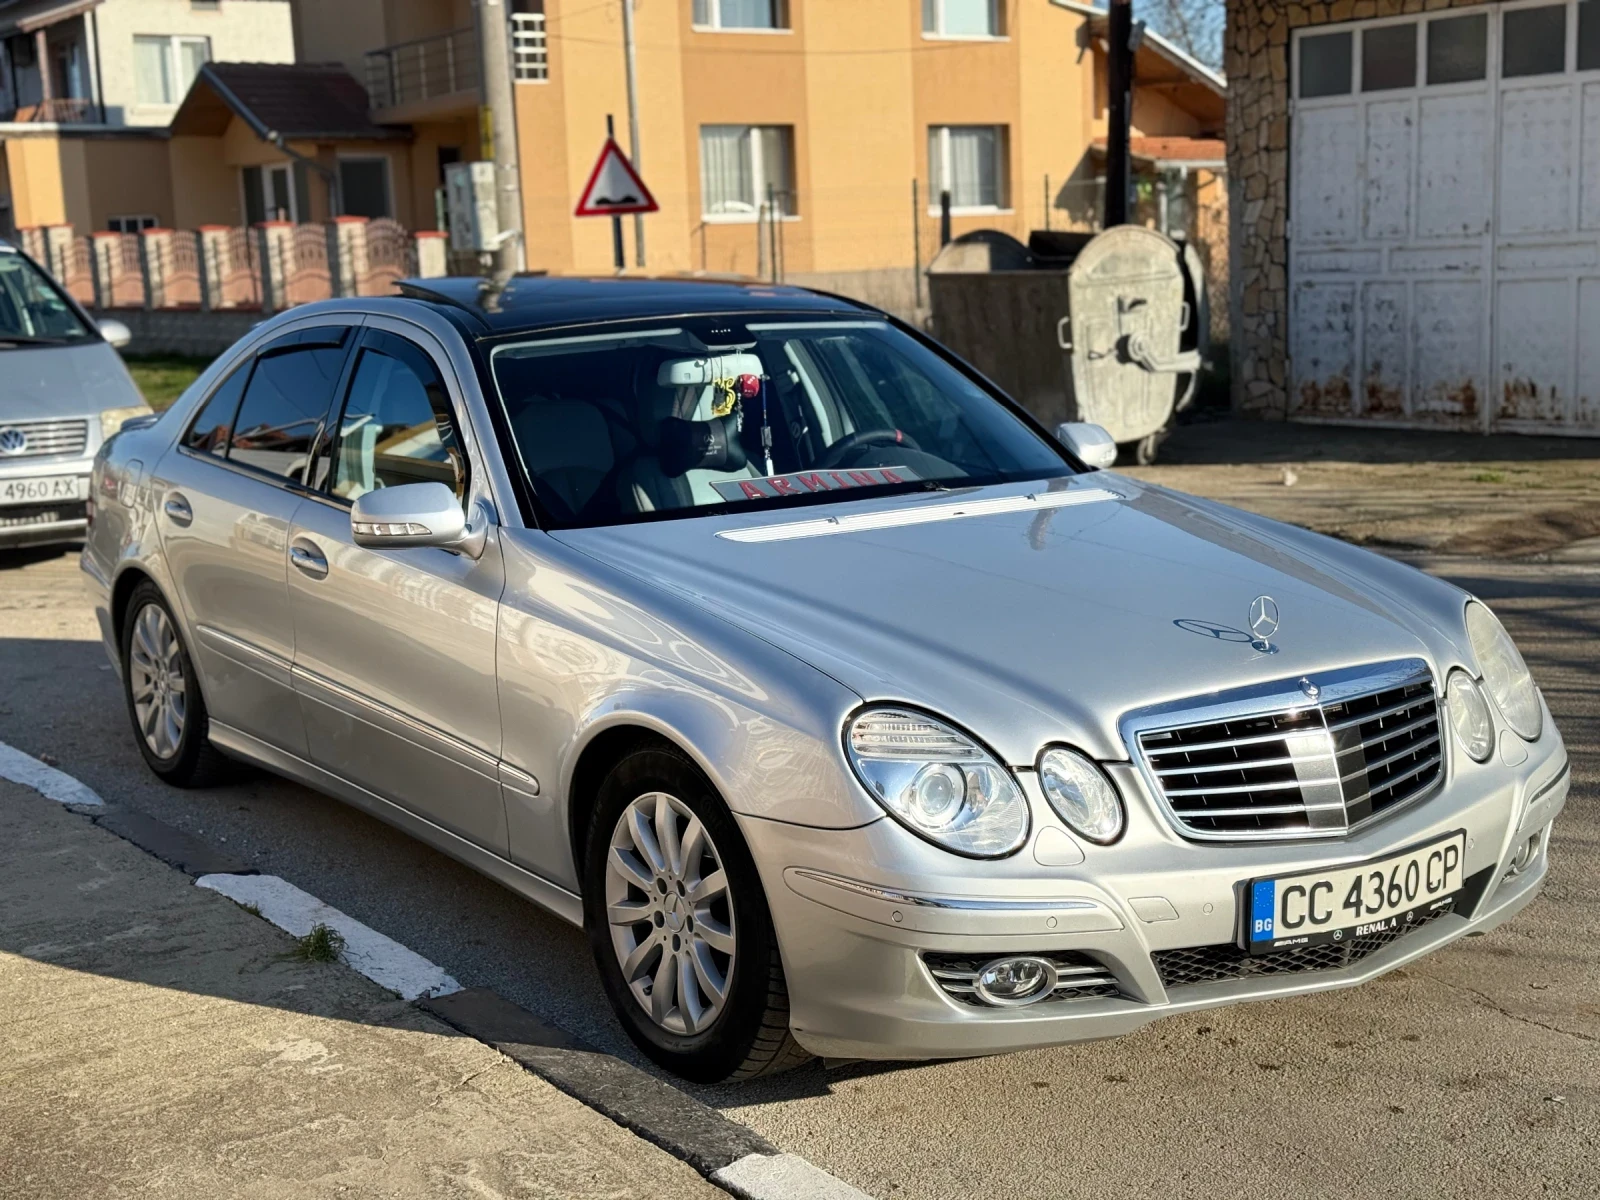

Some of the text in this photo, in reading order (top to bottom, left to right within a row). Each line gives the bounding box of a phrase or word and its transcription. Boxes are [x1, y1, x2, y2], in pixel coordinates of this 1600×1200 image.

[5, 482, 48, 499] 4960
[737, 469, 905, 499] ARMINA
[1281, 844, 1459, 929] CC 4360 CP
[1255, 918, 1272, 933] BG
